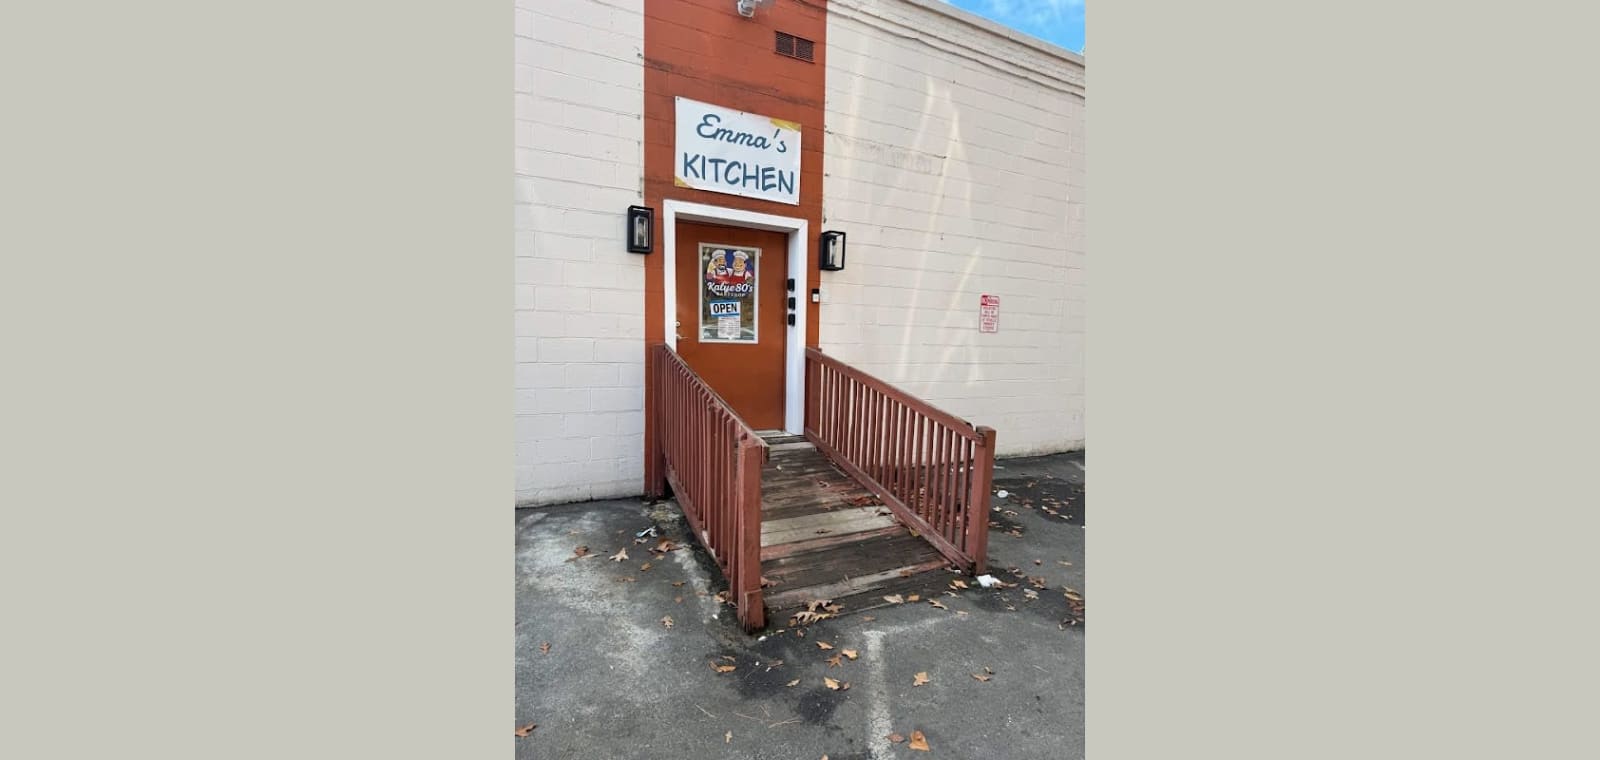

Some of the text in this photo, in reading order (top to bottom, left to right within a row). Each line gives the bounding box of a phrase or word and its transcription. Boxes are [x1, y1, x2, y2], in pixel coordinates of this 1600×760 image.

[696, 114, 787, 153] Emma's
[683, 152, 794, 194] KITCHEN
[713, 303, 737, 313] OPEN
